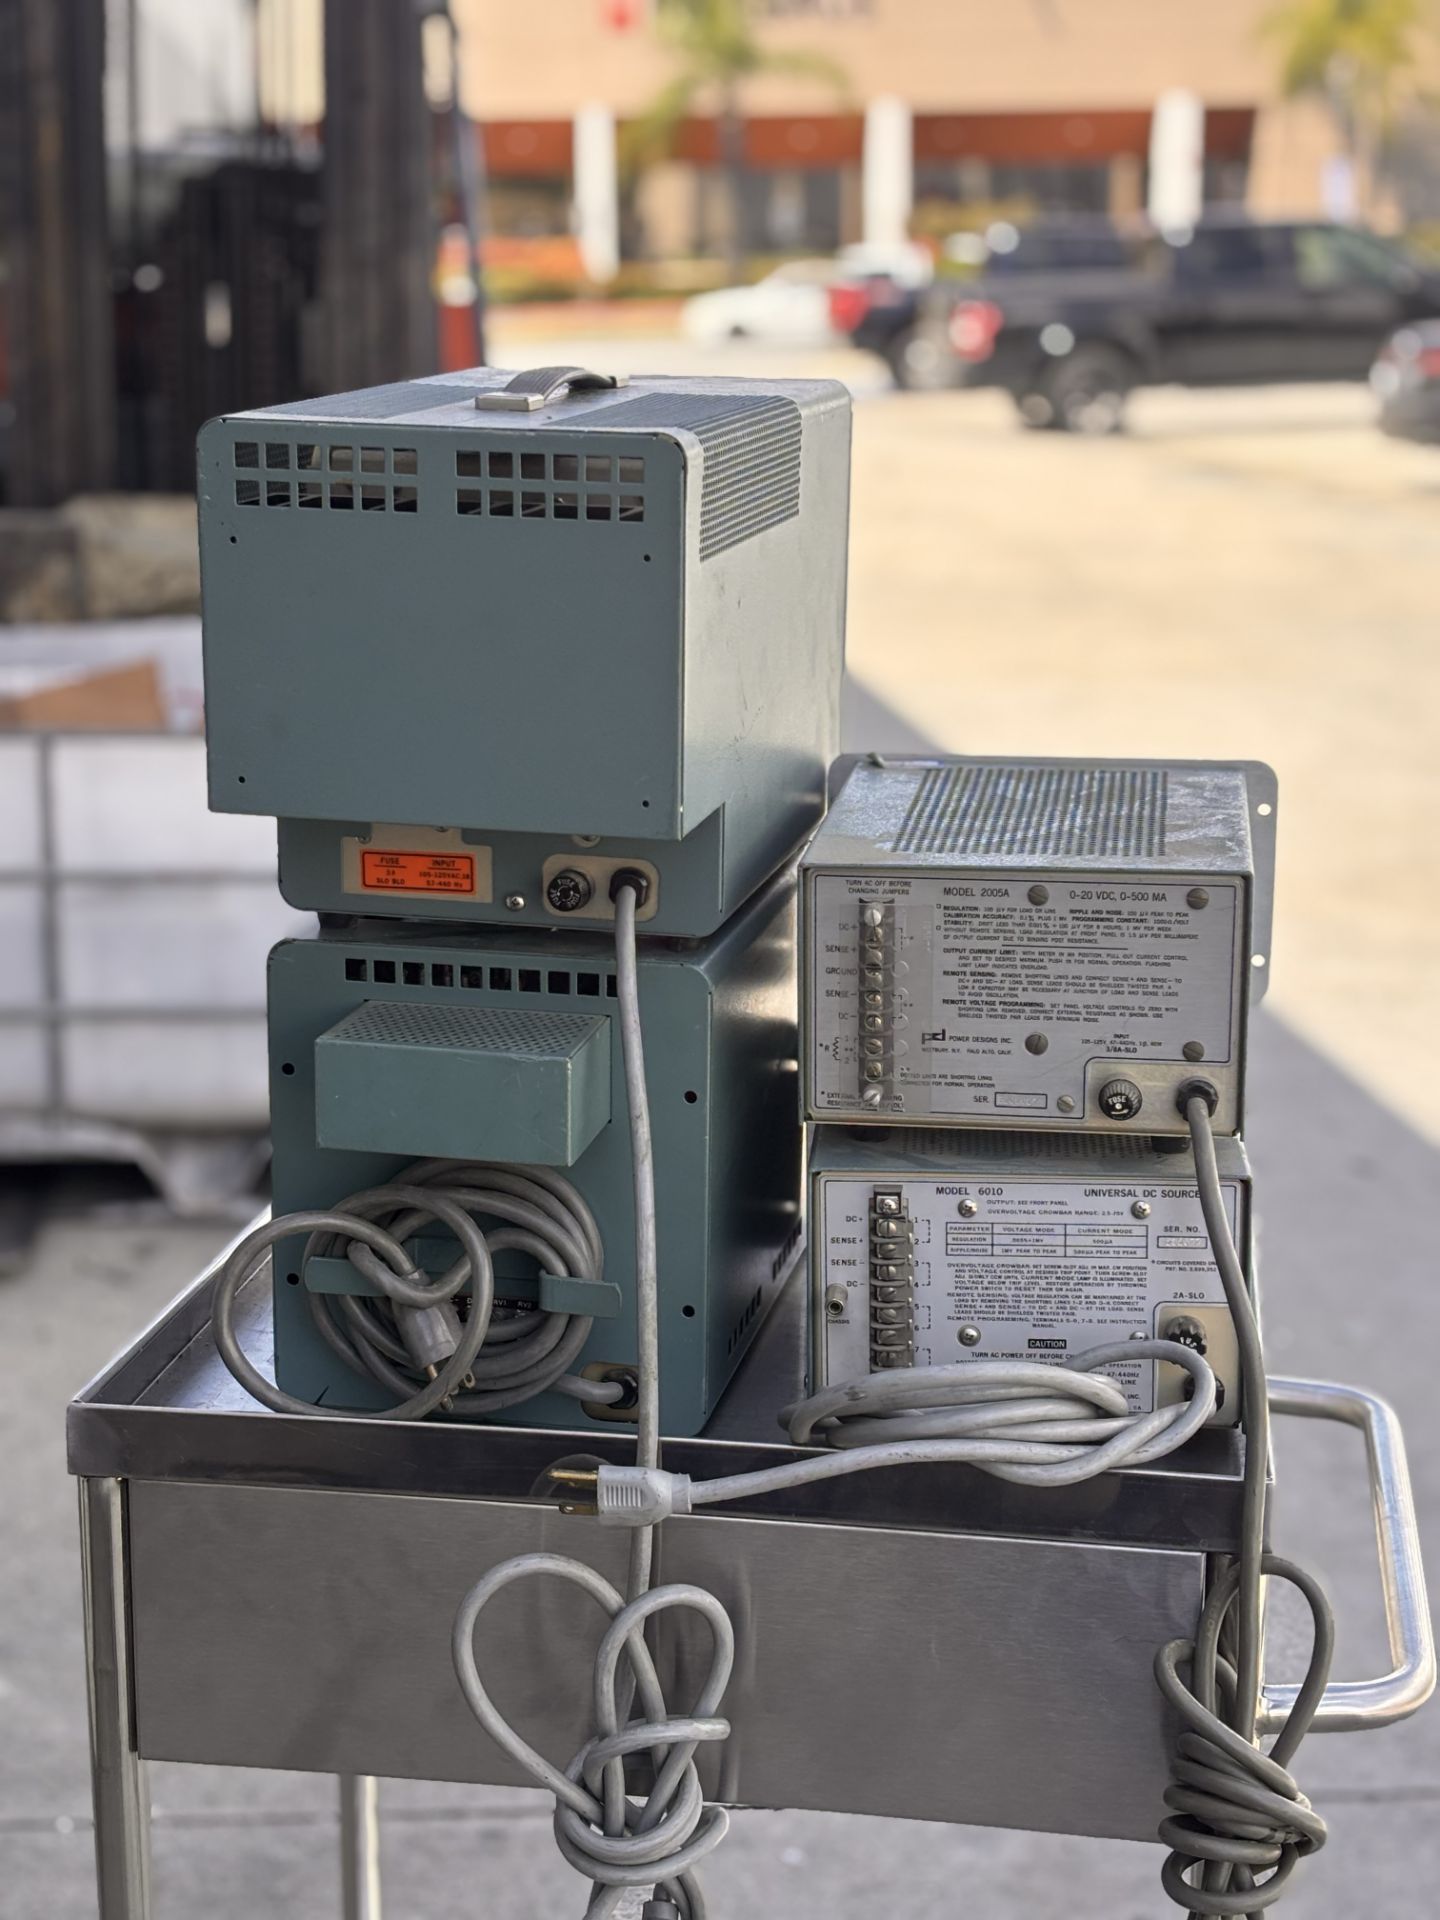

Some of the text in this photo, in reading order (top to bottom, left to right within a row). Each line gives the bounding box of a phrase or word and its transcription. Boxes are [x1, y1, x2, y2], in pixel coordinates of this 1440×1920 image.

[380, 857, 400, 865] FUSE
[944, 888, 1010, 897] MODEL 2005A
[1070, 890, 1167, 902] 0-20 VDC, 0-500 MA
[1108, 1095, 1128, 1105] FUSE
[936, 1187, 1004, 1196] MODEL 6010
[1084, 1189, 1200, 1198] UNIVERSAL DC SOURCE
